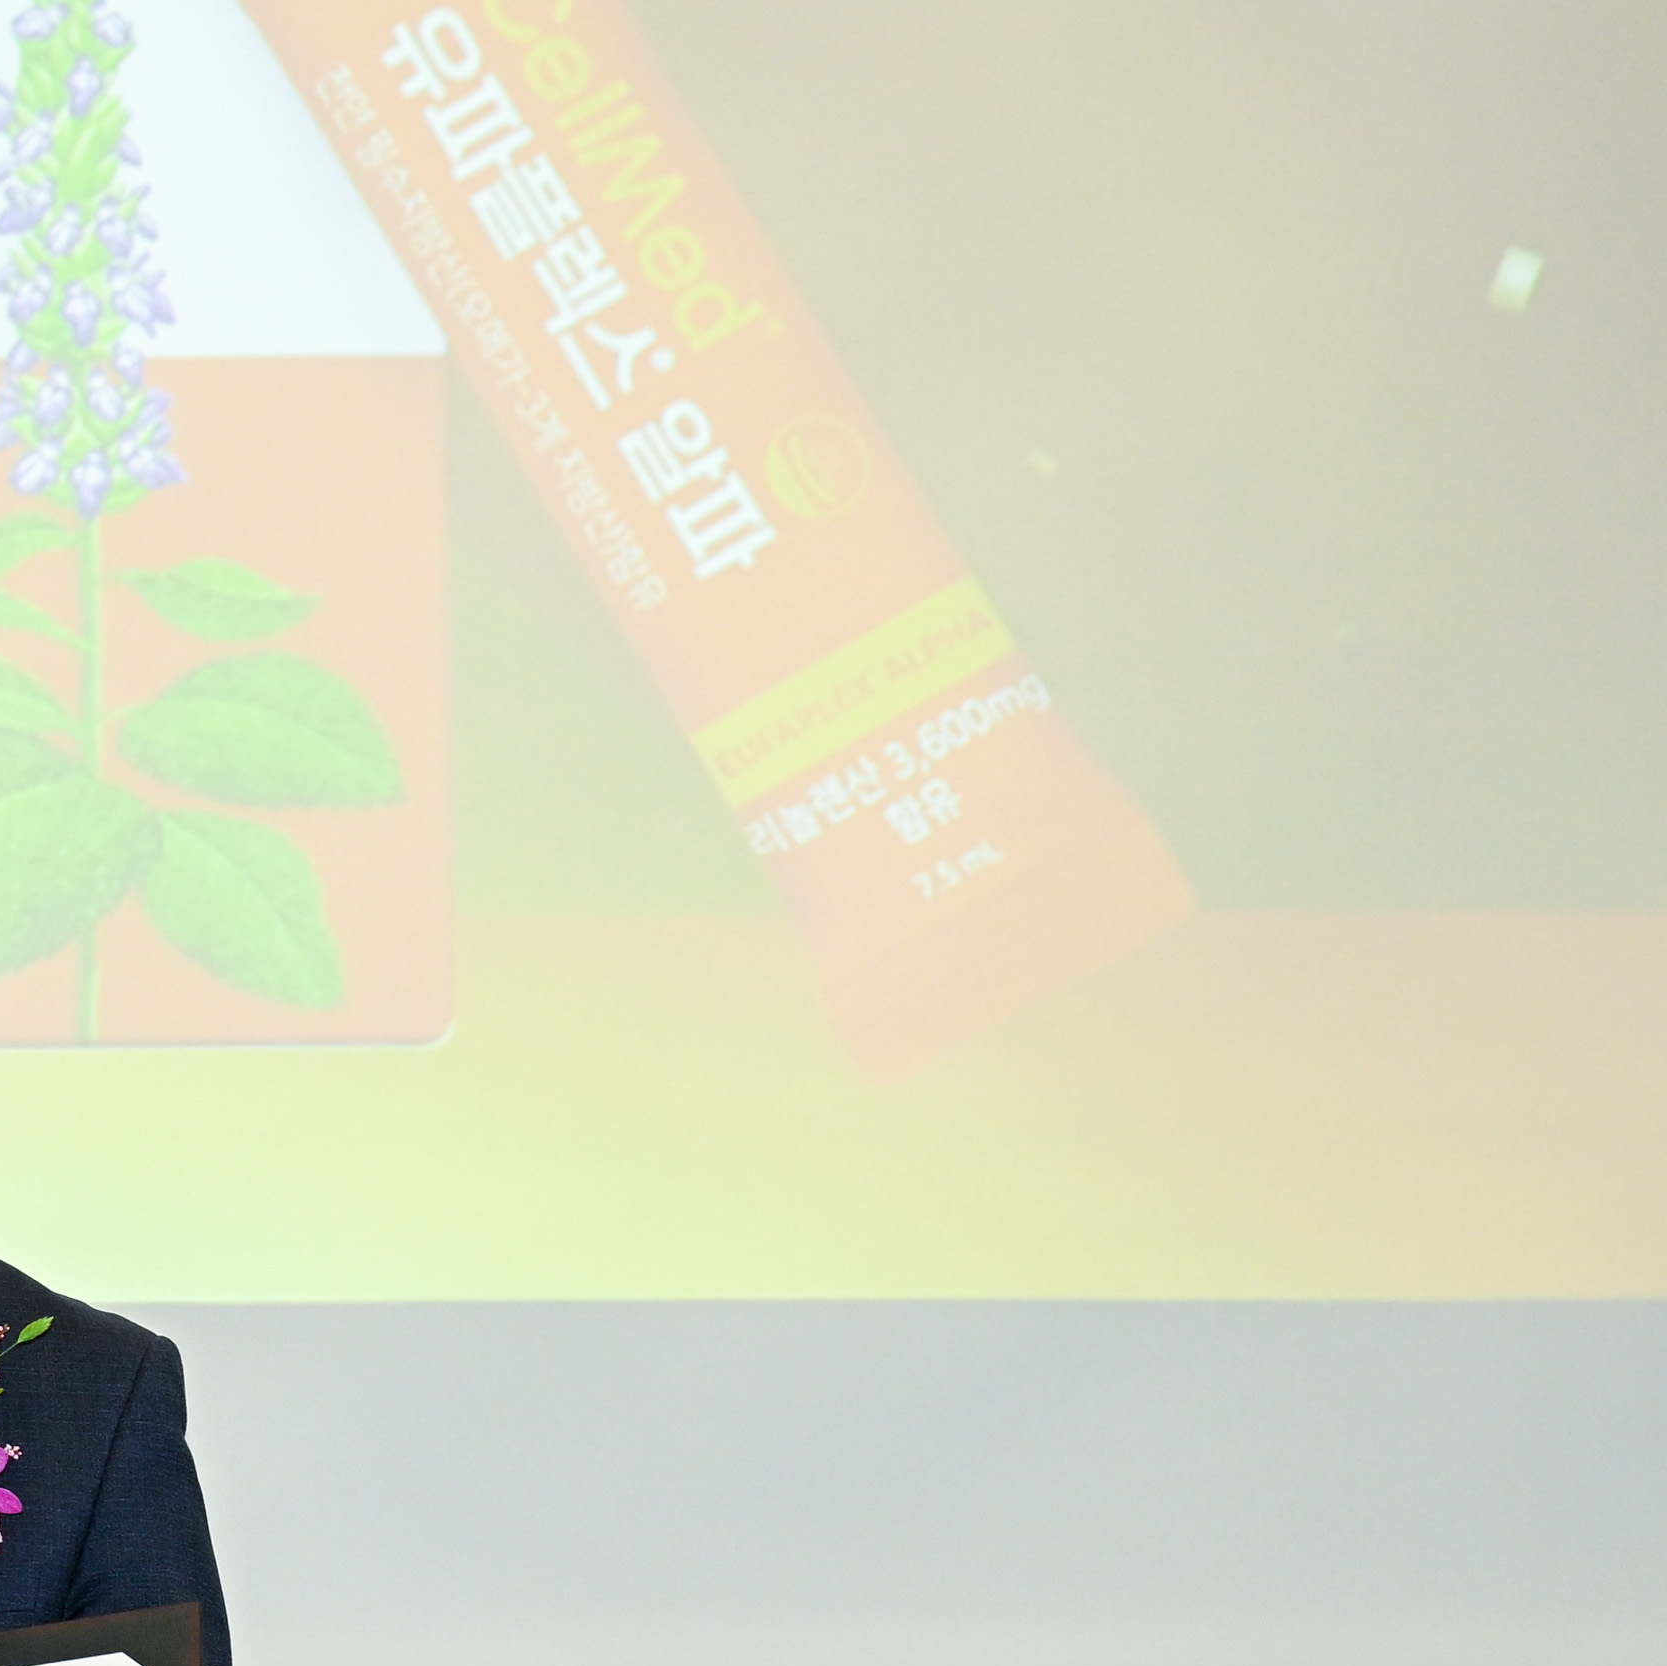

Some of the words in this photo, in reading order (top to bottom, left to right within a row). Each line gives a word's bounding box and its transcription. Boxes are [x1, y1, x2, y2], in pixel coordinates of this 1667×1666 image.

[617, 398, 776, 580] 알파
[714, 660, 880, 779] EUFAPLEX
[884, 609, 994, 684] ALPHA
[746, 756, 887, 856] 리놀렌산
[884, 671, 1052, 780] 3,600mg
[884, 777, 961, 845] 함유
